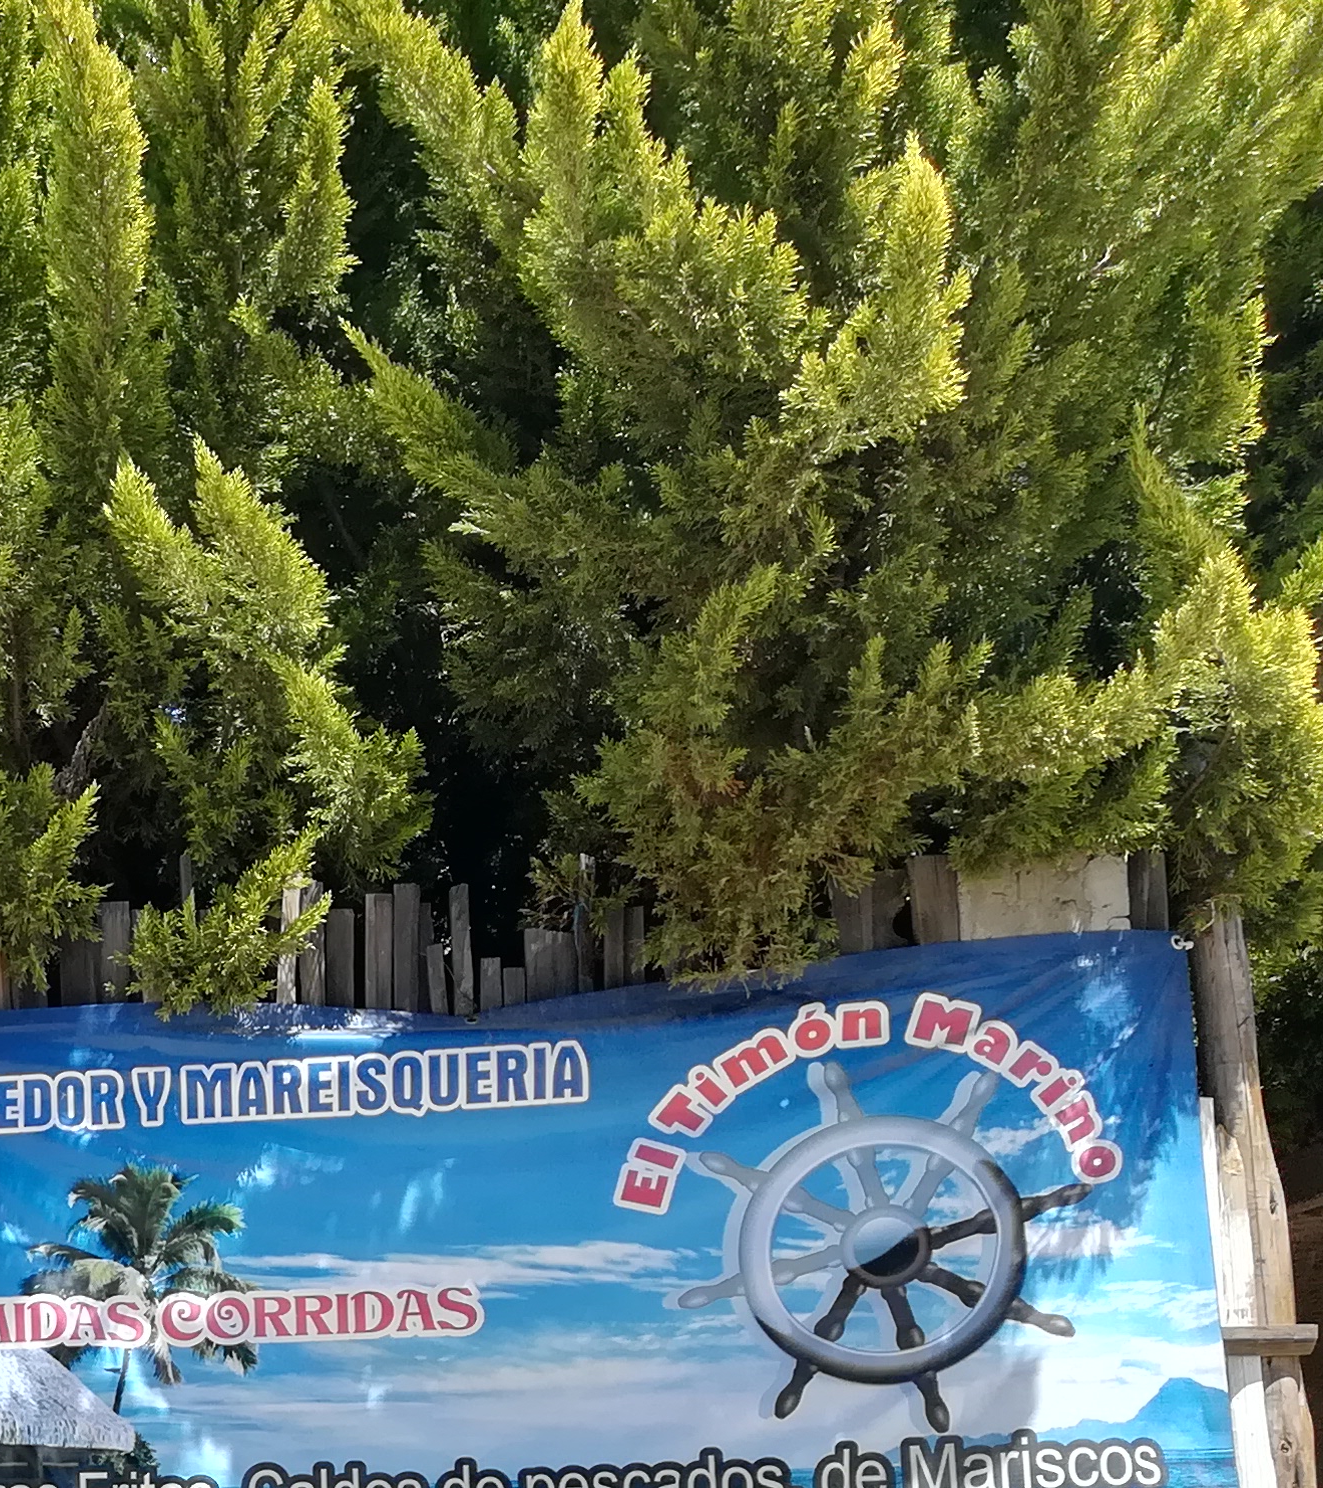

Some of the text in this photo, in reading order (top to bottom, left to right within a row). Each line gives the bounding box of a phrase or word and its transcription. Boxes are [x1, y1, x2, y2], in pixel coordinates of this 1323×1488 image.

[140, 1066, 170, 1128] Y
[182, 1040, 589, 1125] MAREISQUERIA
[613, 991, 1124, 1215] El Timón Marino
[159, 1283, 482, 1346] CORRIDAS
